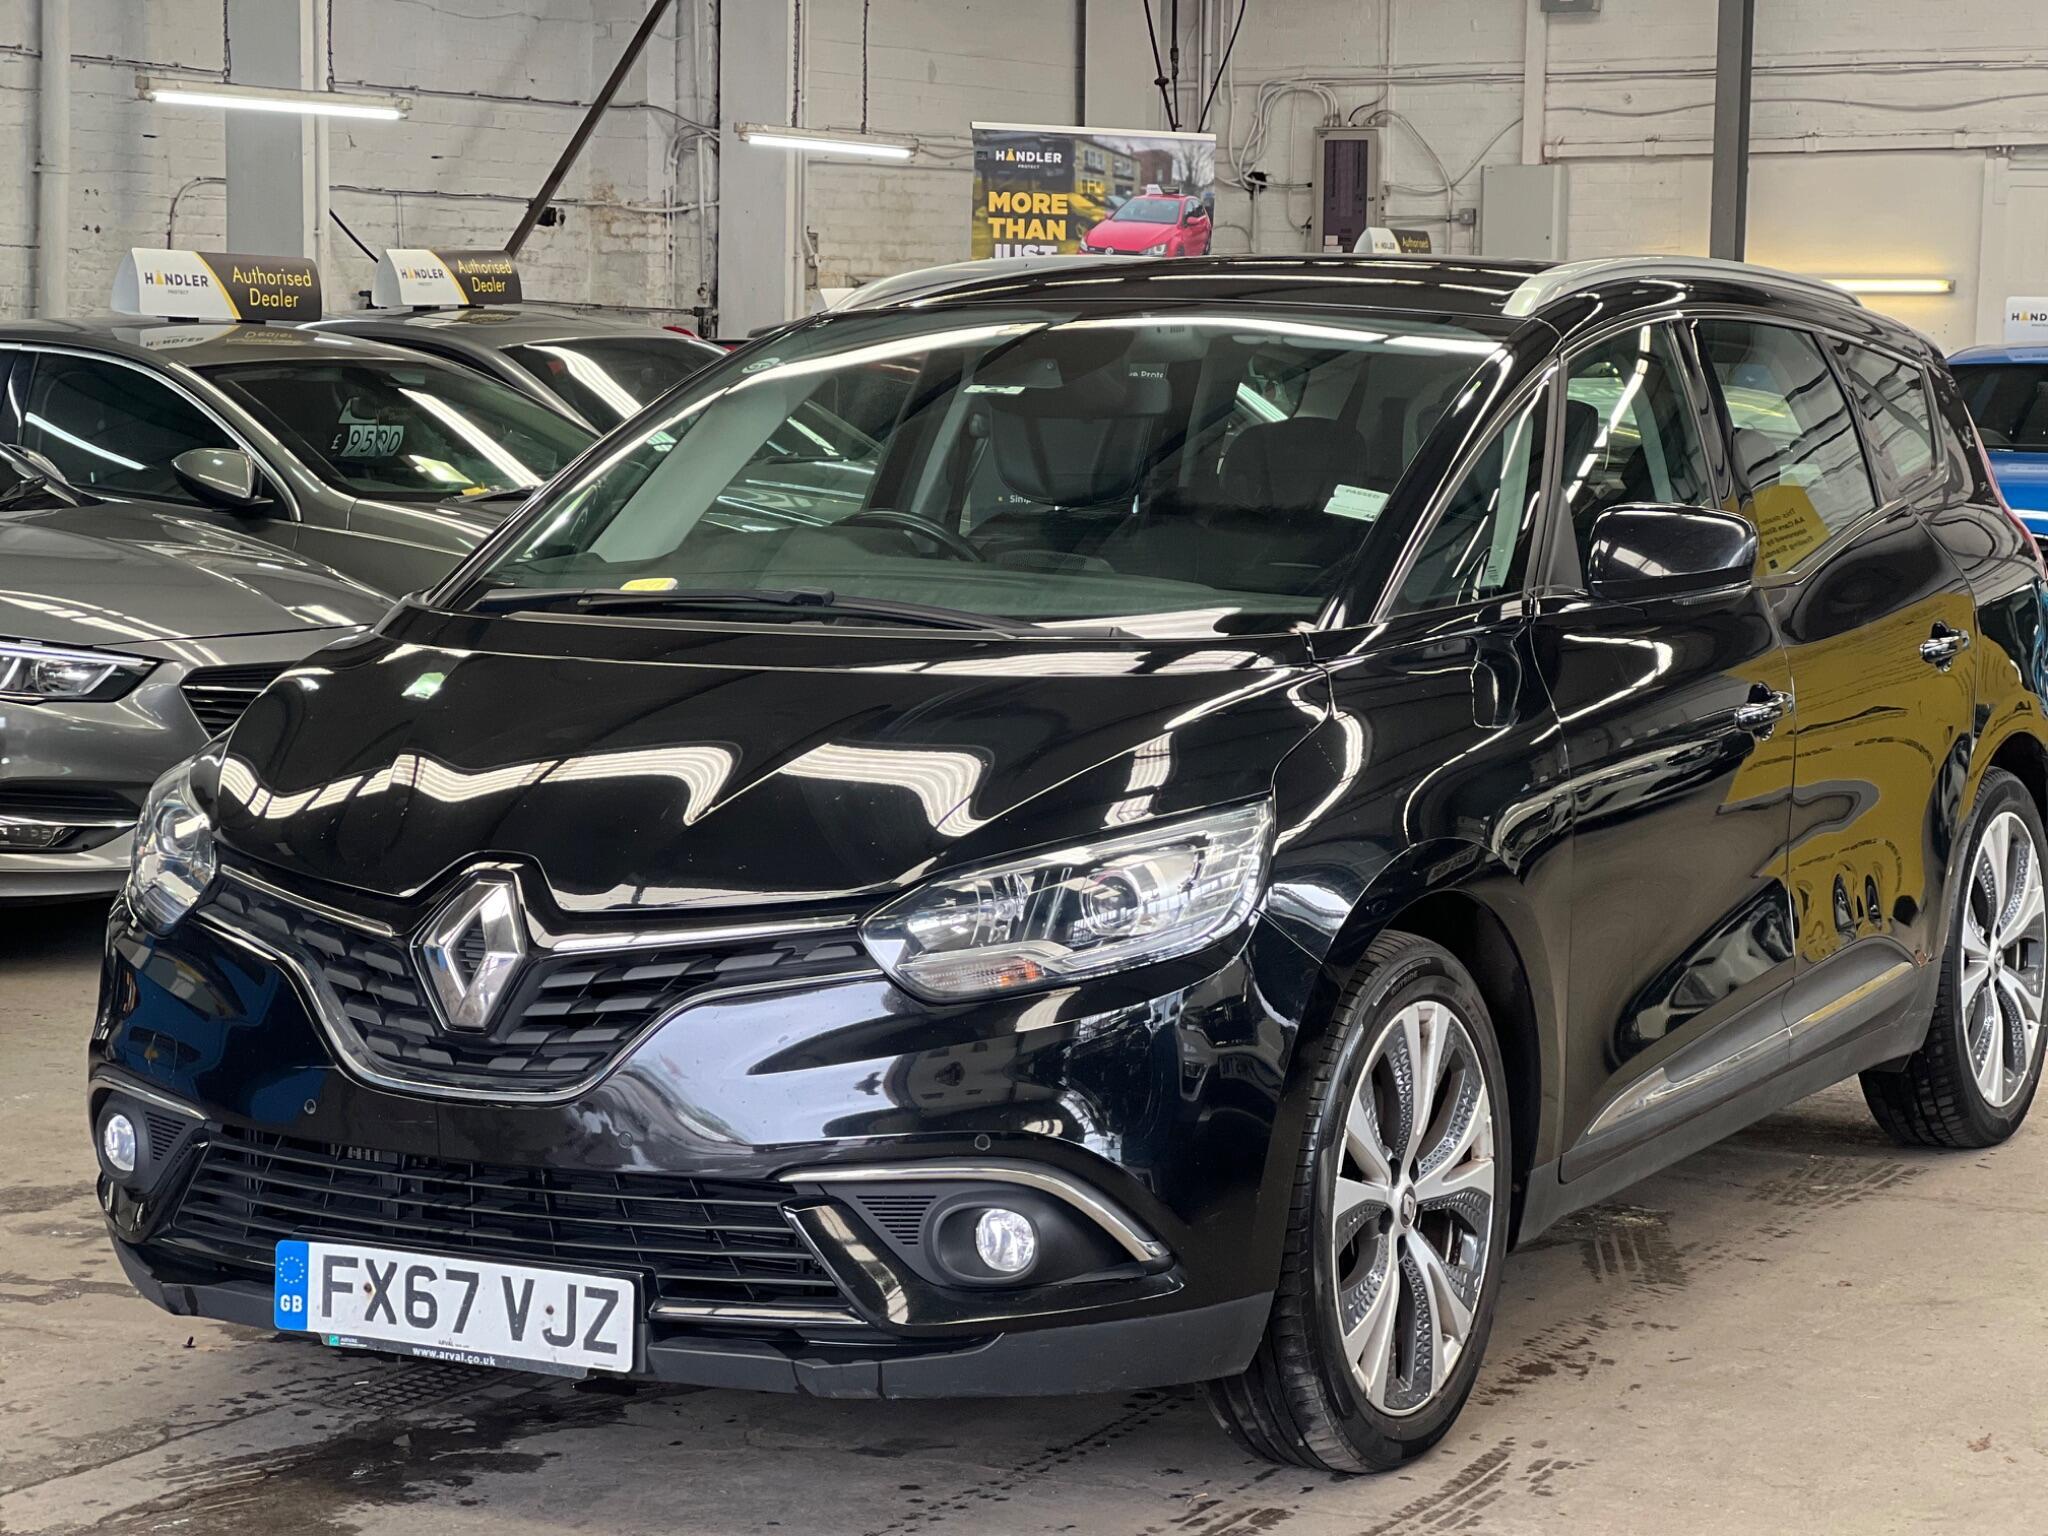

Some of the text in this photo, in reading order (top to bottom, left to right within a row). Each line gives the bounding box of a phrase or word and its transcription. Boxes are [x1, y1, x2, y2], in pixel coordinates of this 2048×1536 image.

[995, 148, 1062, 163] HANDLER
[988, 191, 1068, 215] MORE
[988, 218, 1067, 241] THAN
[232, 266, 312, 288] Authorised
[400, 265, 445, 279] HANDLER
[457, 259, 513, 275] Authorised
[144, 269, 209, 288] HANDLER
[472, 277, 506, 293] Dealer
[250, 287, 300, 308] Dealer
[279, 1295, 304, 1314] GB
[321, 1253, 620, 1356] FX67 VJZ
[412, 1345, 497, 1367] www.arval.co.uk
